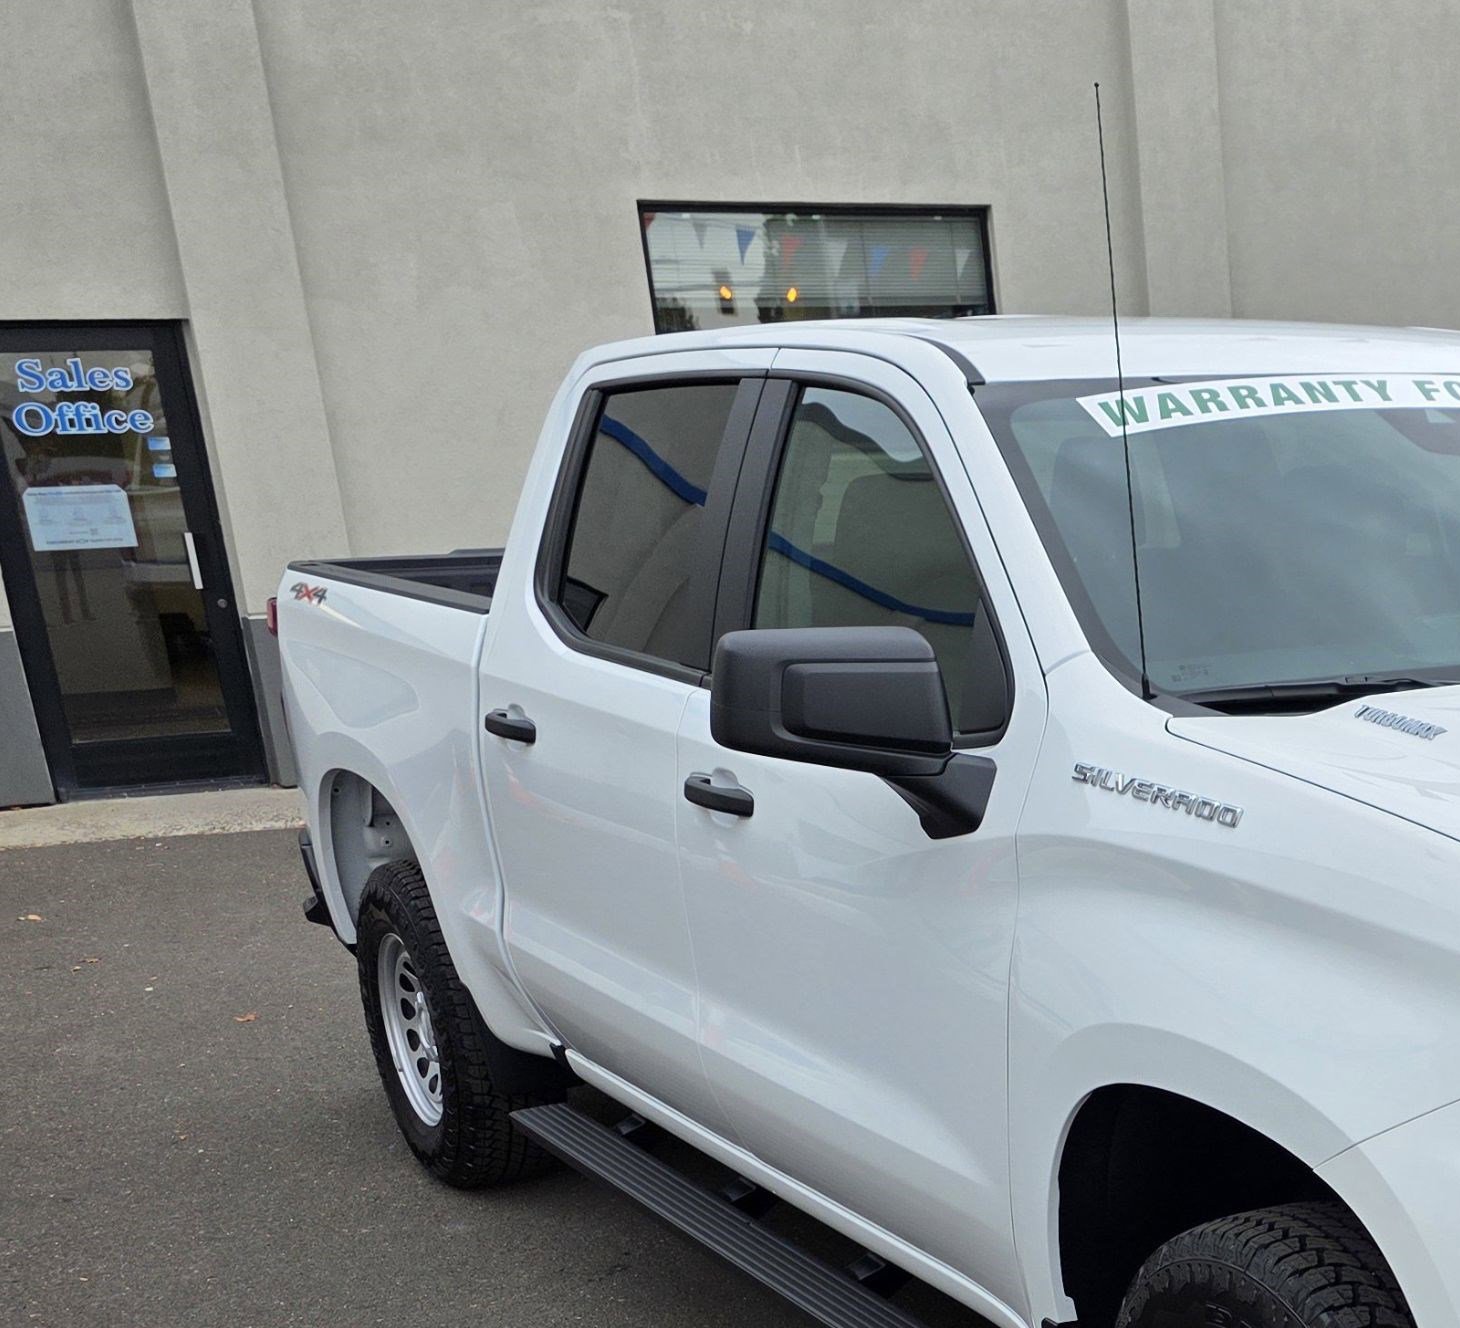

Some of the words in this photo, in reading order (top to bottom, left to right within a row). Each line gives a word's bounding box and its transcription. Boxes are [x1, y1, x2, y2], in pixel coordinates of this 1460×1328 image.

[15, 357, 134, 392] Sales
[12, 401, 154, 436] Office
[1098, 379, 1392, 428] WARRANTY
[1072, 762, 1244, 829] SILVERADO
